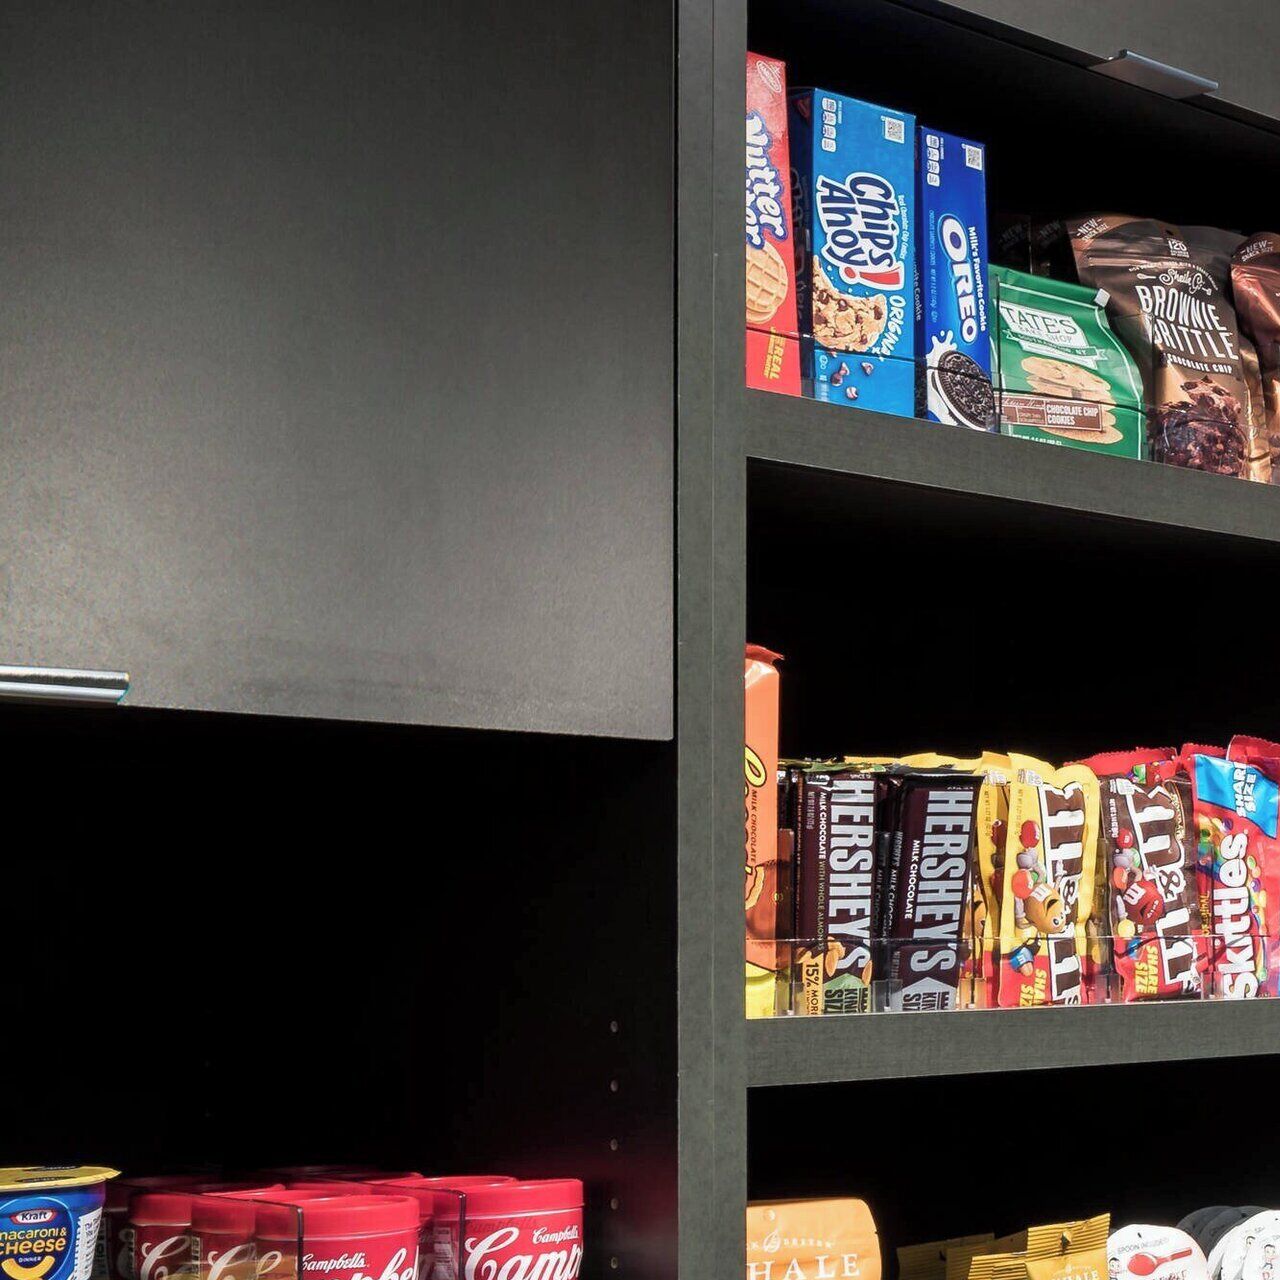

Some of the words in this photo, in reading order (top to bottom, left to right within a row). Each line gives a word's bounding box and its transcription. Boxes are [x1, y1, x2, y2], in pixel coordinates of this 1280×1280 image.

[849, 175, 896, 269] Chips
[967, 226, 978, 256] Milk's
[942, 217, 977, 343] OREO
[973, 256, 984, 297] Favorite
[978, 298, 987, 332] Cookie
[1000, 305, 1077, 335] TATE'S
[1135, 284, 1228, 332] BROWNIE
[1146, 318, 1240, 361] BRITTLE
[1211, 363, 1233, 375] CHIP
[1046, 403, 1082, 417] CHOCOLATE
[1082, 406, 1099, 418] CHIP
[1046, 414, 1076, 426] COOKIES
[1244, 773, 1257, 812] SIZE
[818, 811, 828, 861] CHOCOLATE
[911, 839, 921, 861] MILK
[827, 778, 876, 976] HERSHEY'S
[904, 861, 918, 920] CHOCOLATE
[910, 789, 975, 973] HERSHEY'S
[1211, 832, 1258, 998] Skittles
[805, 962, 820, 988] 15%
[1134, 961, 1151, 994] SIZE
[1146, 945, 1159, 995] SHARE
[20, 1209, 49, 1223] Kraft
